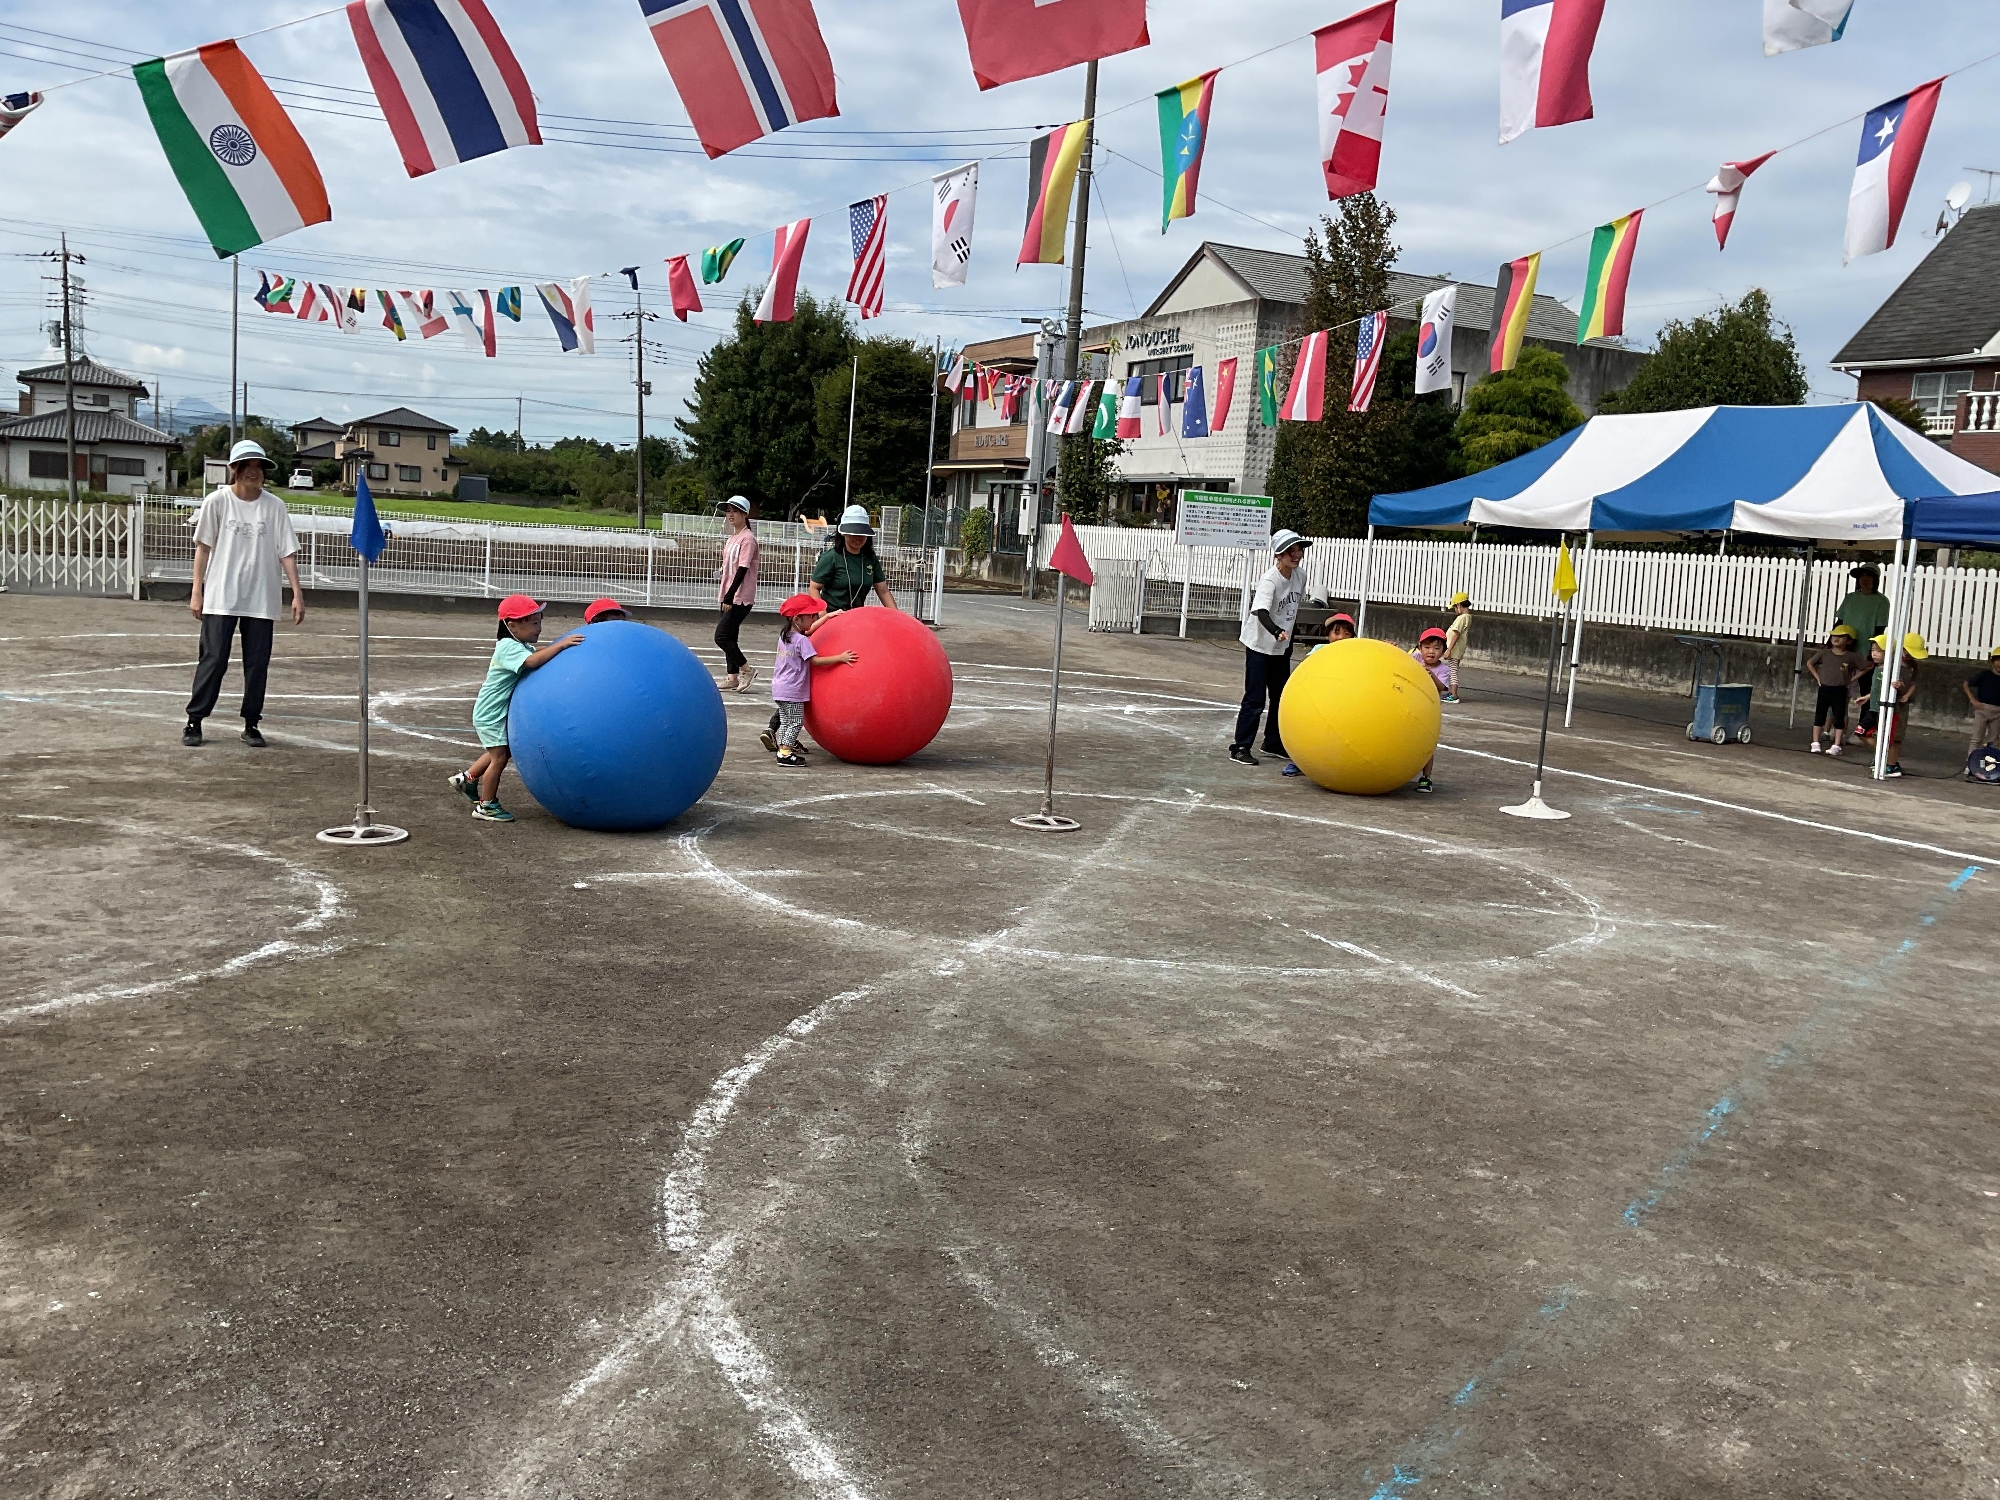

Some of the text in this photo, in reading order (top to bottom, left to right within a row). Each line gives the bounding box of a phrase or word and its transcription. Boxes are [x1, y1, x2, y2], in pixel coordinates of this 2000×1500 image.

[1125, 327, 1180, 349] JONOUCHI
[1147, 342, 1195, 356] NURSERY SCHOOL
[974, 434, 1010, 447] EDUCARE
